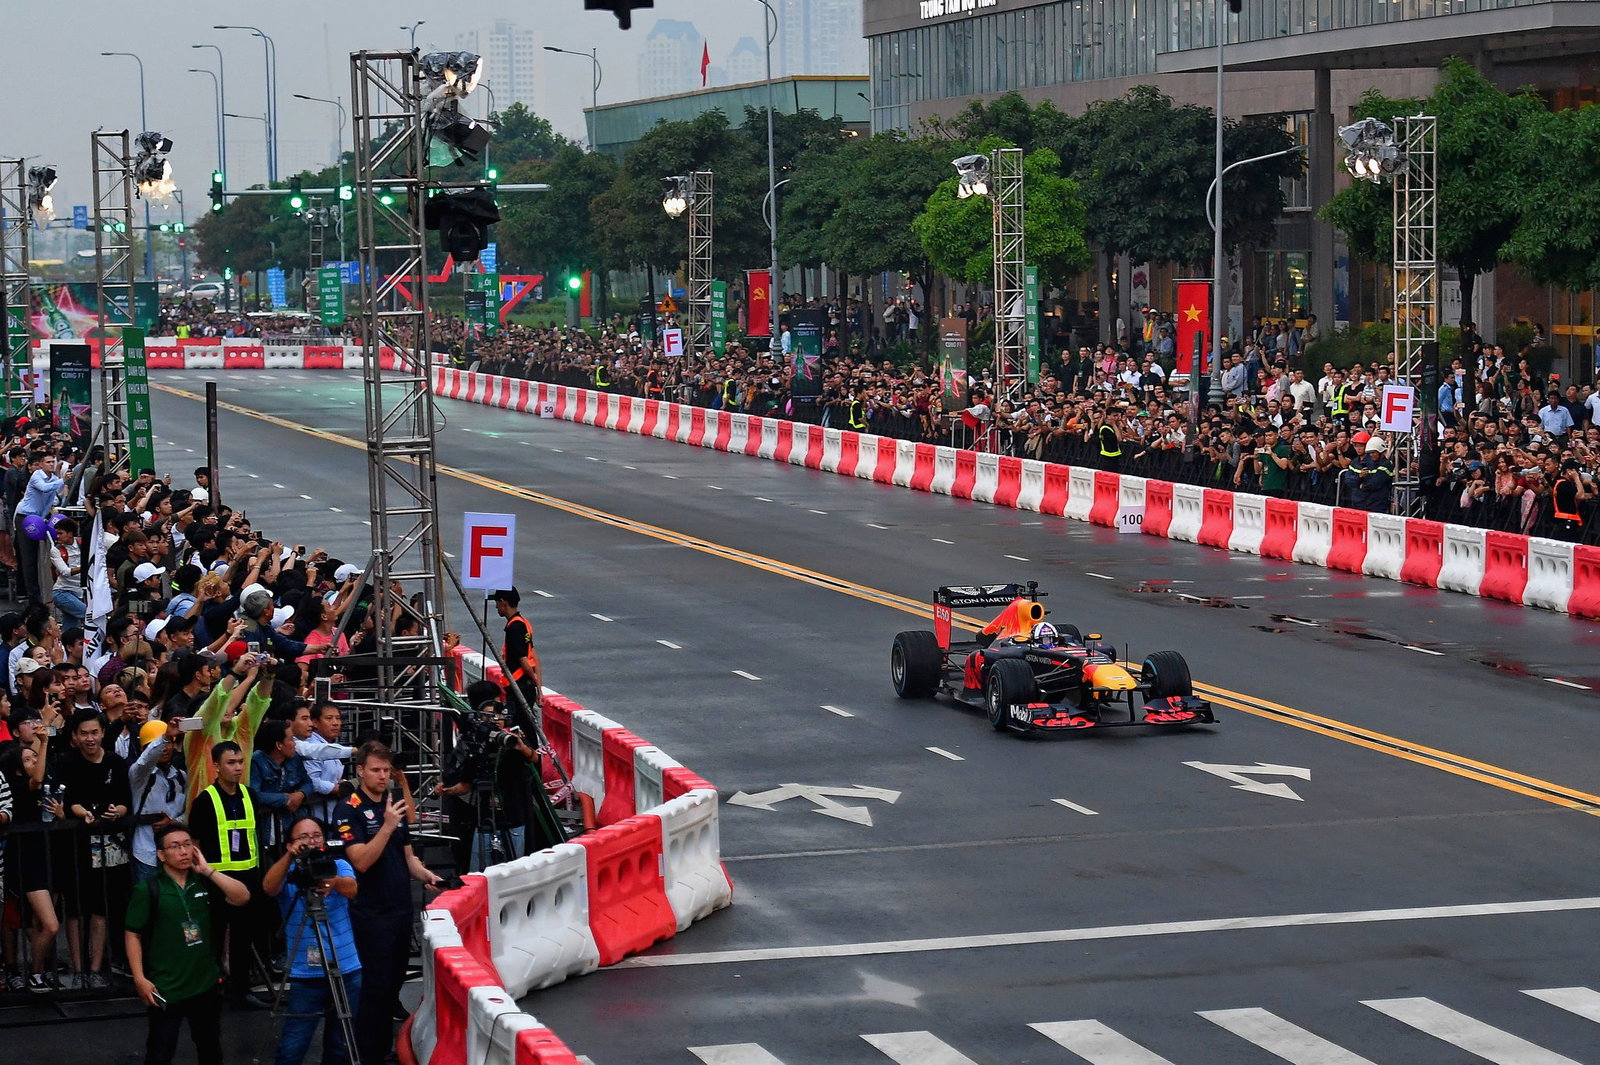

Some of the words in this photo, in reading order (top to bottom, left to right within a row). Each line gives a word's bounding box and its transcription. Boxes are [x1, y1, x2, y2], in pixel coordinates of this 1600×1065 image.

[665, 333, 679, 353] F
[544, 405, 554, 413] 50
[1385, 392, 1410, 424] F
[1121, 513, 1144, 525] 100
[469, 525, 508, 578] F
